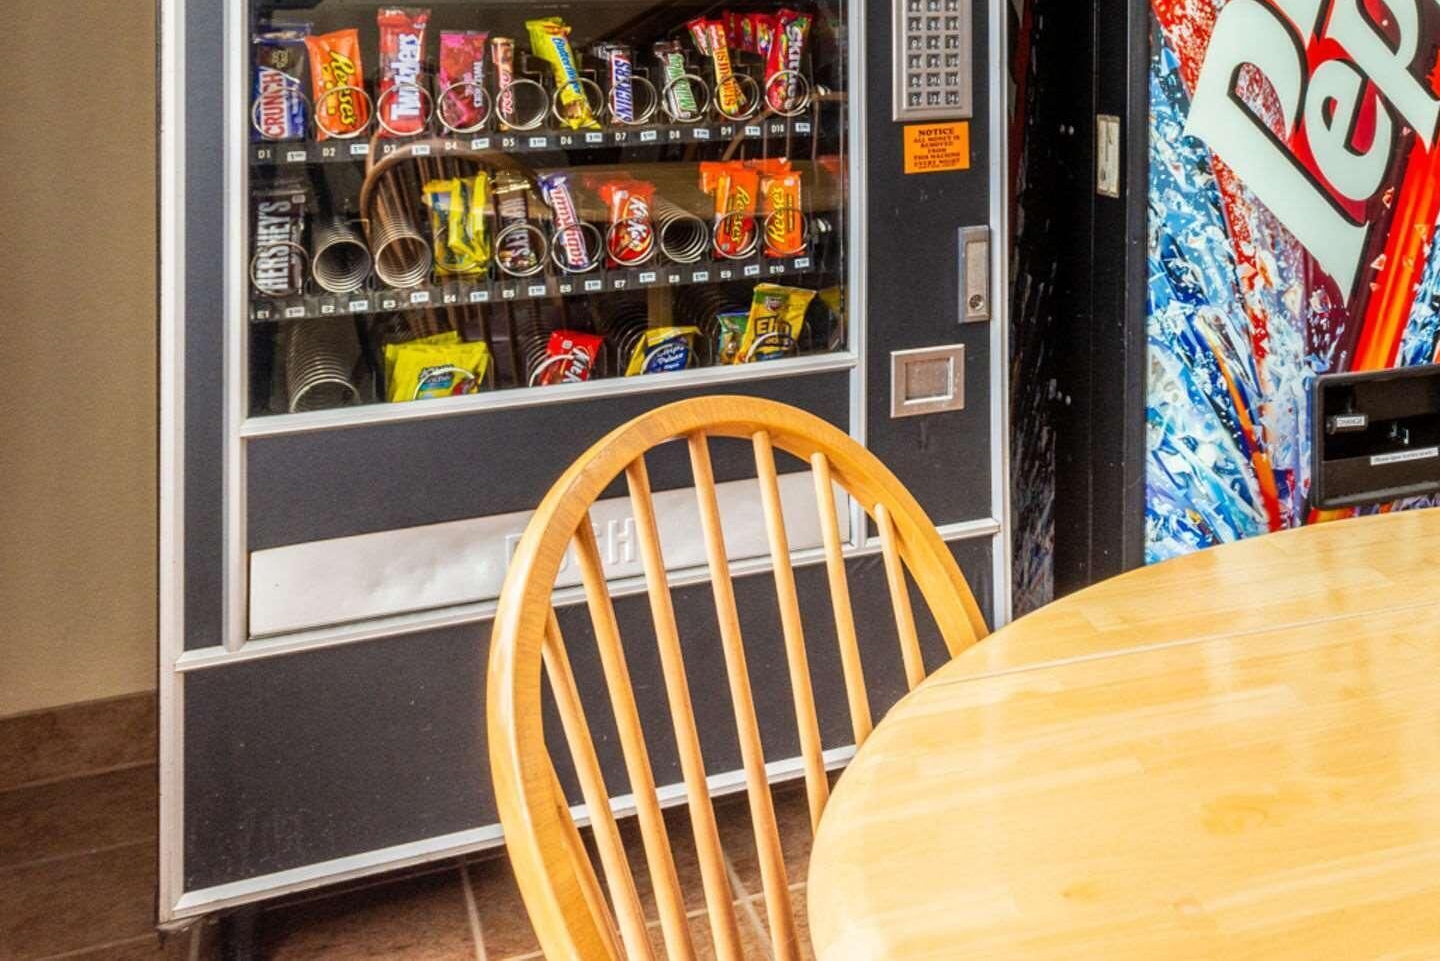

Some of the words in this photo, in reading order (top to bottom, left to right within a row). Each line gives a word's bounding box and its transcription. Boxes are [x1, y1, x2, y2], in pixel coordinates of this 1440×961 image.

[329, 50, 356, 125] Reese's
[614, 59, 634, 122] SNICKERS
[262, 72, 285, 137] CRUNCH
[720, 127, 732, 135] D9
[918, 127, 954, 136] NOTICE
[560, 136, 572, 145] D6
[615, 132, 627, 141] D7
[445, 142, 457, 151] D4
[502, 138, 515, 147] D5
[258, 149, 271, 159] D1
[322, 147, 335, 157] D2
[768, 187, 785, 243] Reese's
[770, 264, 785, 274] E10
[614, 279, 626, 288] E7
